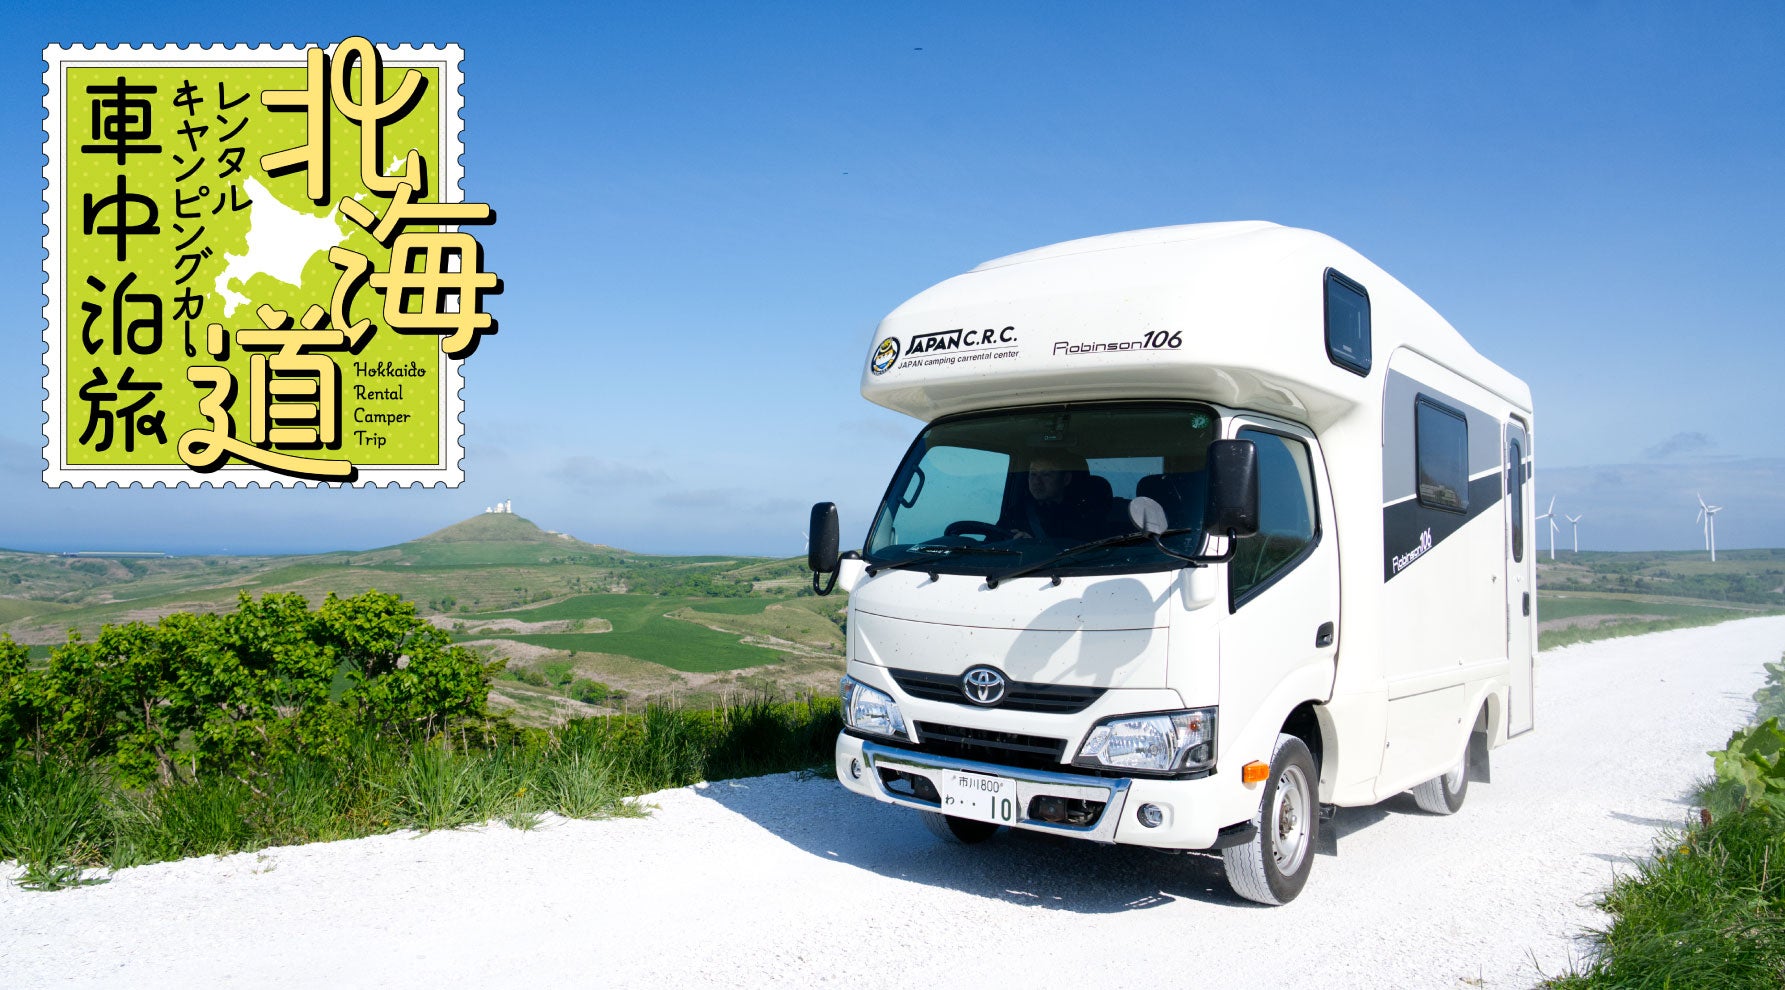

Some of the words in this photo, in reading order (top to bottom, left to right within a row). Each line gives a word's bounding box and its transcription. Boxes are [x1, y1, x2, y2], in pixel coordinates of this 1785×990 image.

[905, 329, 963, 356] JAPAN
[963, 326, 1018, 346] C.R.C.
[898, 360, 923, 369] JAPAN
[924, 355, 956, 366] camping
[957, 351, 992, 363] carrental
[993, 350, 1019, 360] center
[991, 796, 1011, 821] 10
